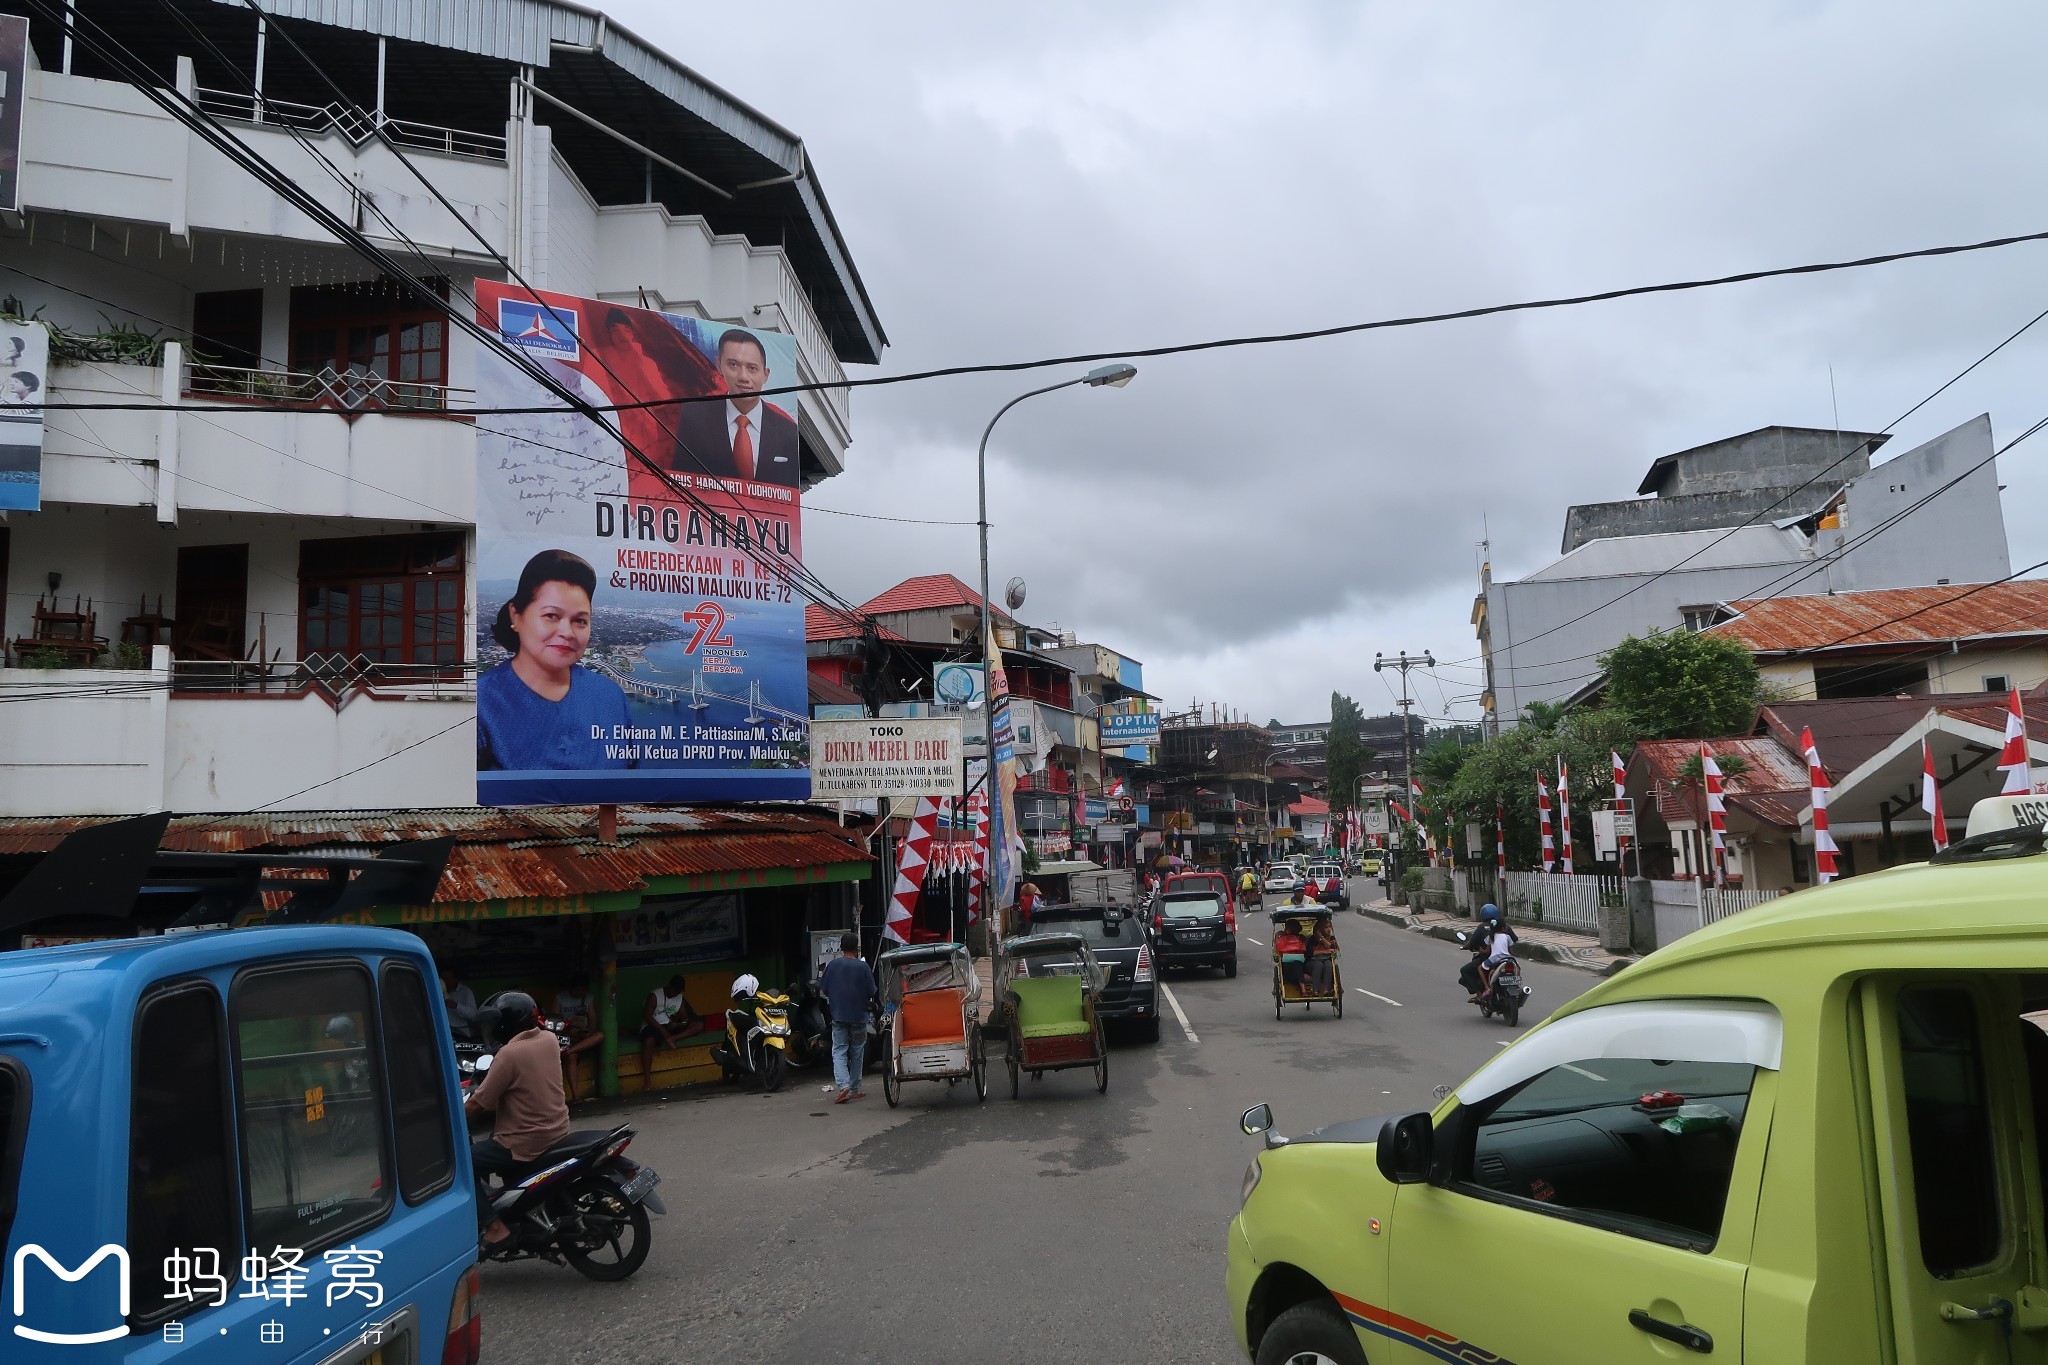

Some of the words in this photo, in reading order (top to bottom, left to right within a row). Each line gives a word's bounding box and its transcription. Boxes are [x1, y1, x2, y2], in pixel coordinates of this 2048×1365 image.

[532, 341, 572, 351] DEMOKRAT
[668, 474, 692, 488] AGUS
[696, 476, 742, 494] HARIMURTI
[746, 483, 792, 502] YUDHOYONO
[595, 501, 791, 556] DIRGAHAYU
[617, 548, 722, 577] KEMERDEKAAN
[732, 559, 745, 578] RI
[754, 561, 791, 583] KE-72
[609, 570, 628, 589] &
[629, 571, 694, 596] PROVINSI
[698, 576, 752, 600] MALUKU
[755, 583, 792, 604] KE-72
[703, 657, 731, 665] KERJA
[703, 665, 744, 674] BERSAMA
[1115, 714, 1158, 727] OPTIK
[591, 725, 609, 740] Dr.
[613, 725, 656, 740] Elviana
[661, 726, 676, 740] M.
[680, 726, 691, 740] E.
[694, 726, 768, 743] Pattiasina/M,
[772, 728, 801, 742] S.Ked
[870, 727, 904, 737] TOKO
[1102, 726, 1159, 736] Internasional
[605, 744, 640, 760] Wakil
[644, 745, 679, 760] Ketua
[683, 745, 715, 760] DPRD
[719, 746, 746, 760] Prov.
[750, 746, 790, 760] Maluku
[824, 741, 864, 762] DUNIA
[868, 740, 909, 762] MEBEL
[914, 739, 949, 761] BARU
[819, 767, 863, 778] MENYEDIAKAN
[864, 766, 899, 777] PERALATAN
[900, 766, 926, 776] KANTOR
[928, 766, 932, 776] &
[934, 766, 953, 776] MEBEL
[688, 870, 768, 892] BECAK
[401, 900, 490, 924] DUNIA
[506, 894, 591, 918] MEBEL
[297, 1204, 314, 1218] FULL
